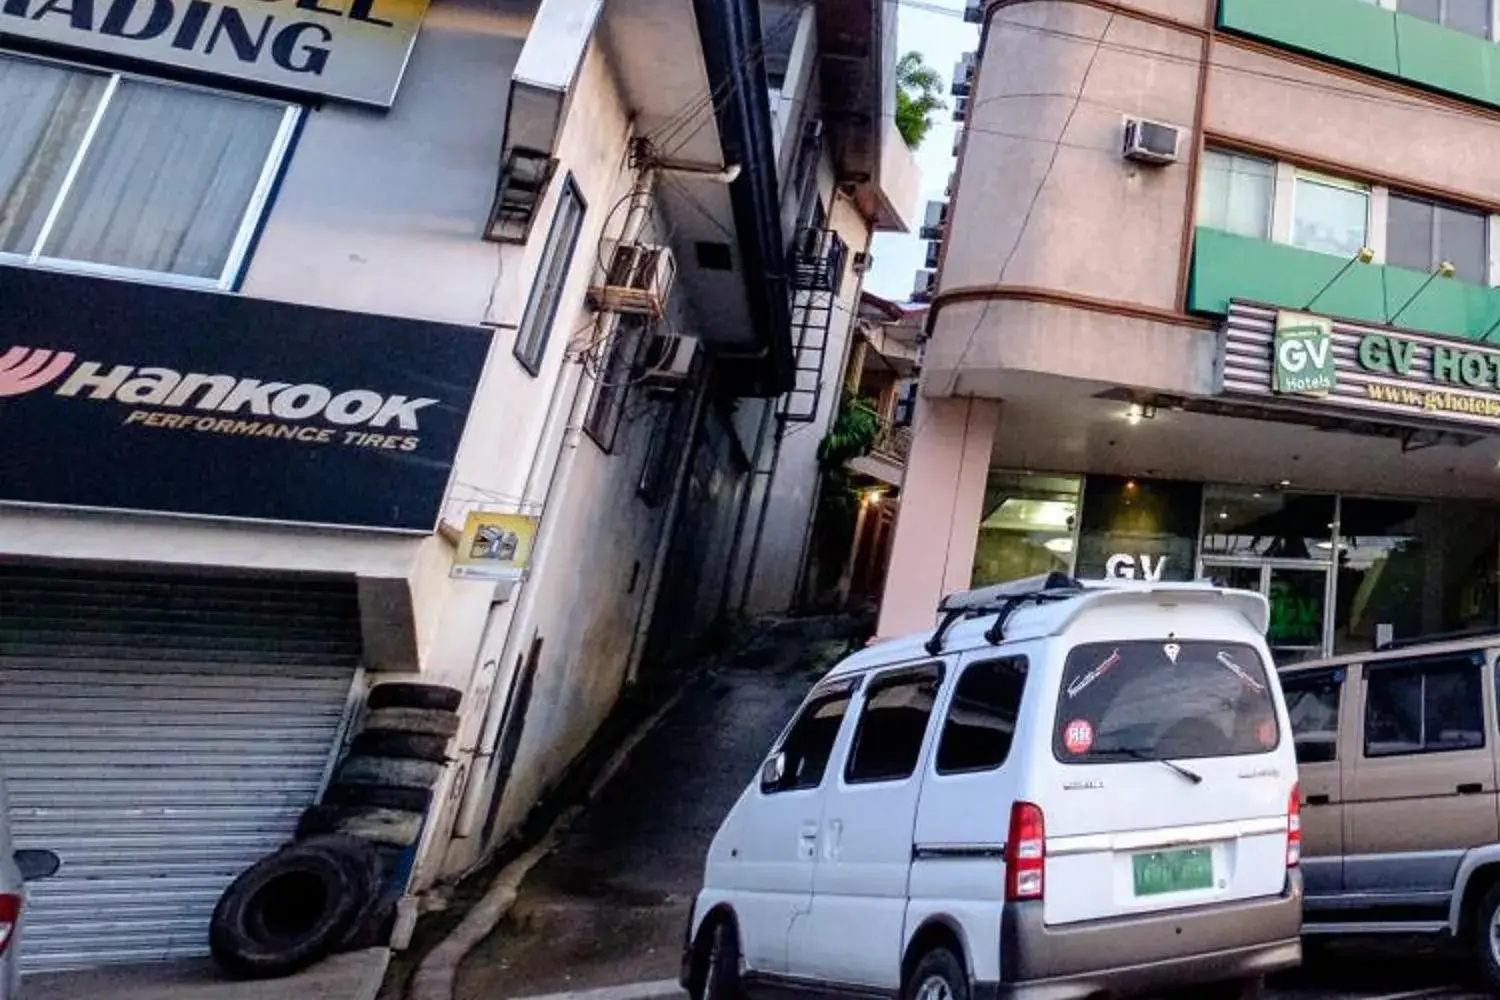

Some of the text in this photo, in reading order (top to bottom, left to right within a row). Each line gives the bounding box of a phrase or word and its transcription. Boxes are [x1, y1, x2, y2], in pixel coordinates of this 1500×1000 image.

[1279, 337, 1329, 373] GV
[1358, 335, 1417, 376] GV
[1285, 374, 1331, 392] Hotels
[125, 410, 421, 451] PERFORMANCE TIRES
[1104, 553, 1168, 581] GV
